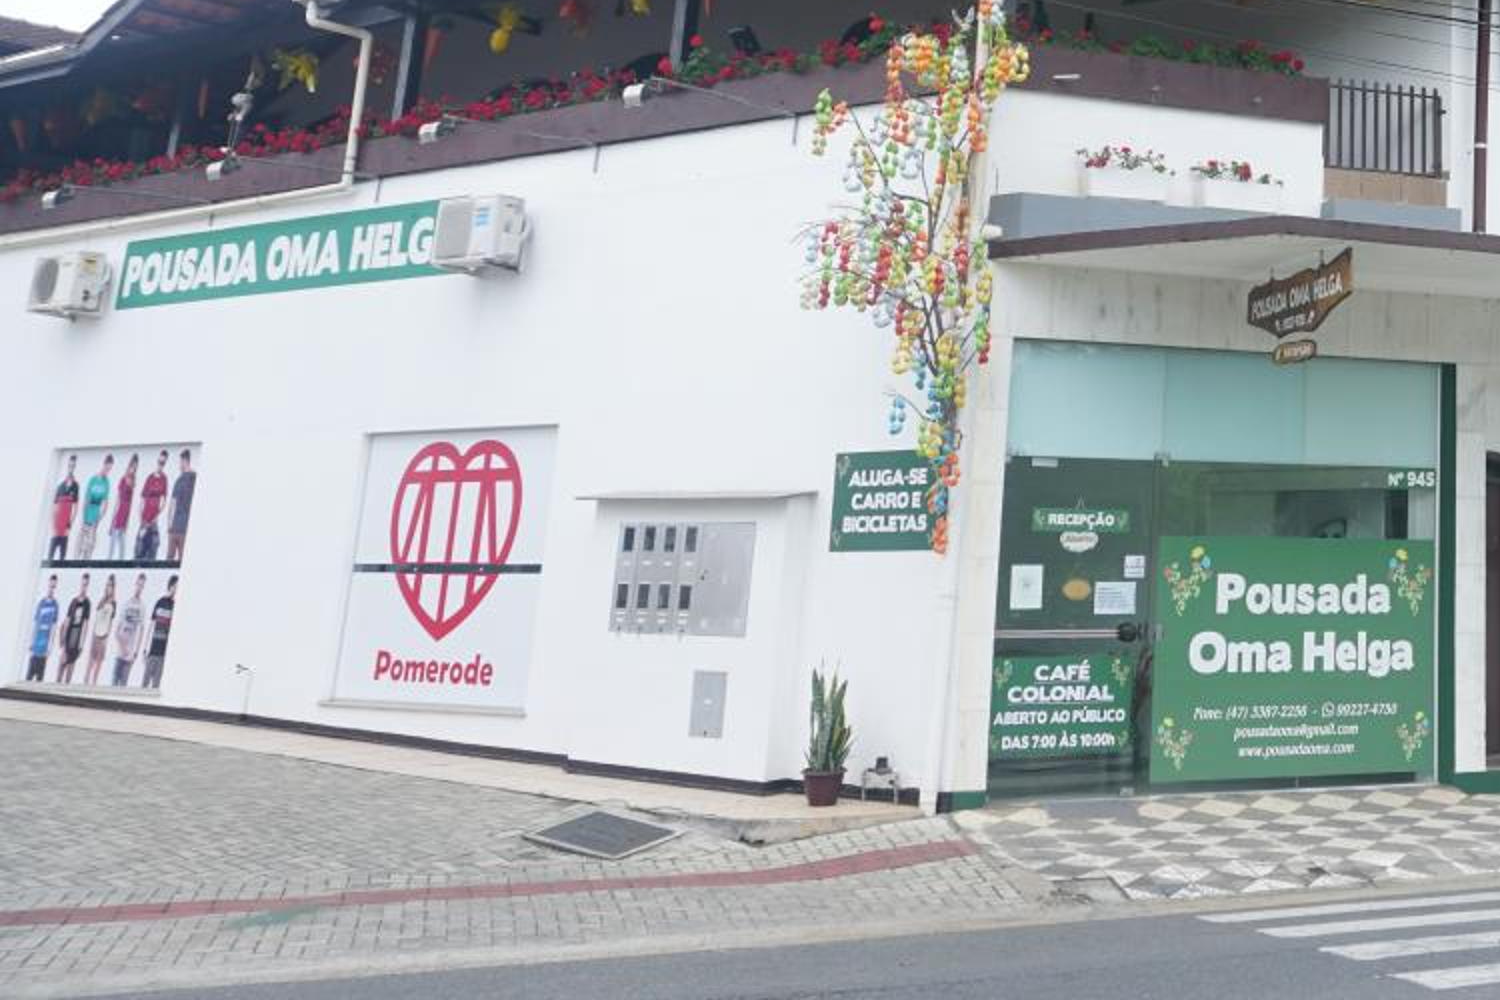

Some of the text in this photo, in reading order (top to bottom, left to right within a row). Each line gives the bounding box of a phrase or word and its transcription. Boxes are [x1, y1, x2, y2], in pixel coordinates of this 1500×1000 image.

[122, 216, 434, 298] POUSADA OMA HELG
[1312, 270, 1344, 301] HELGA
[848, 467, 929, 487] ALUGA-SE
[1407, 471, 1435, 487] 945
[850, 490, 923, 510] CARRO E
[841, 514, 928, 533] BICICLETAS
[1047, 511, 1116, 531] RECEPÇÃO
[1215, 572, 1392, 615] Pousada
[1188, 630, 1415, 678] Oma Helga
[373, 649, 494, 686] Pomerode
[1033, 659, 1092, 681] CAFÉ
[1007, 684, 1115, 703] COLONIAL
[993, 706, 1126, 725] ABERTO AO PÚBLICO
[1225, 704, 1249, 721] (47)
[1001, 735, 1030, 750] DAS
[1059, 731, 1078, 747] ÀS
[1238, 742, 1356, 760] www.pousadaoma.com
